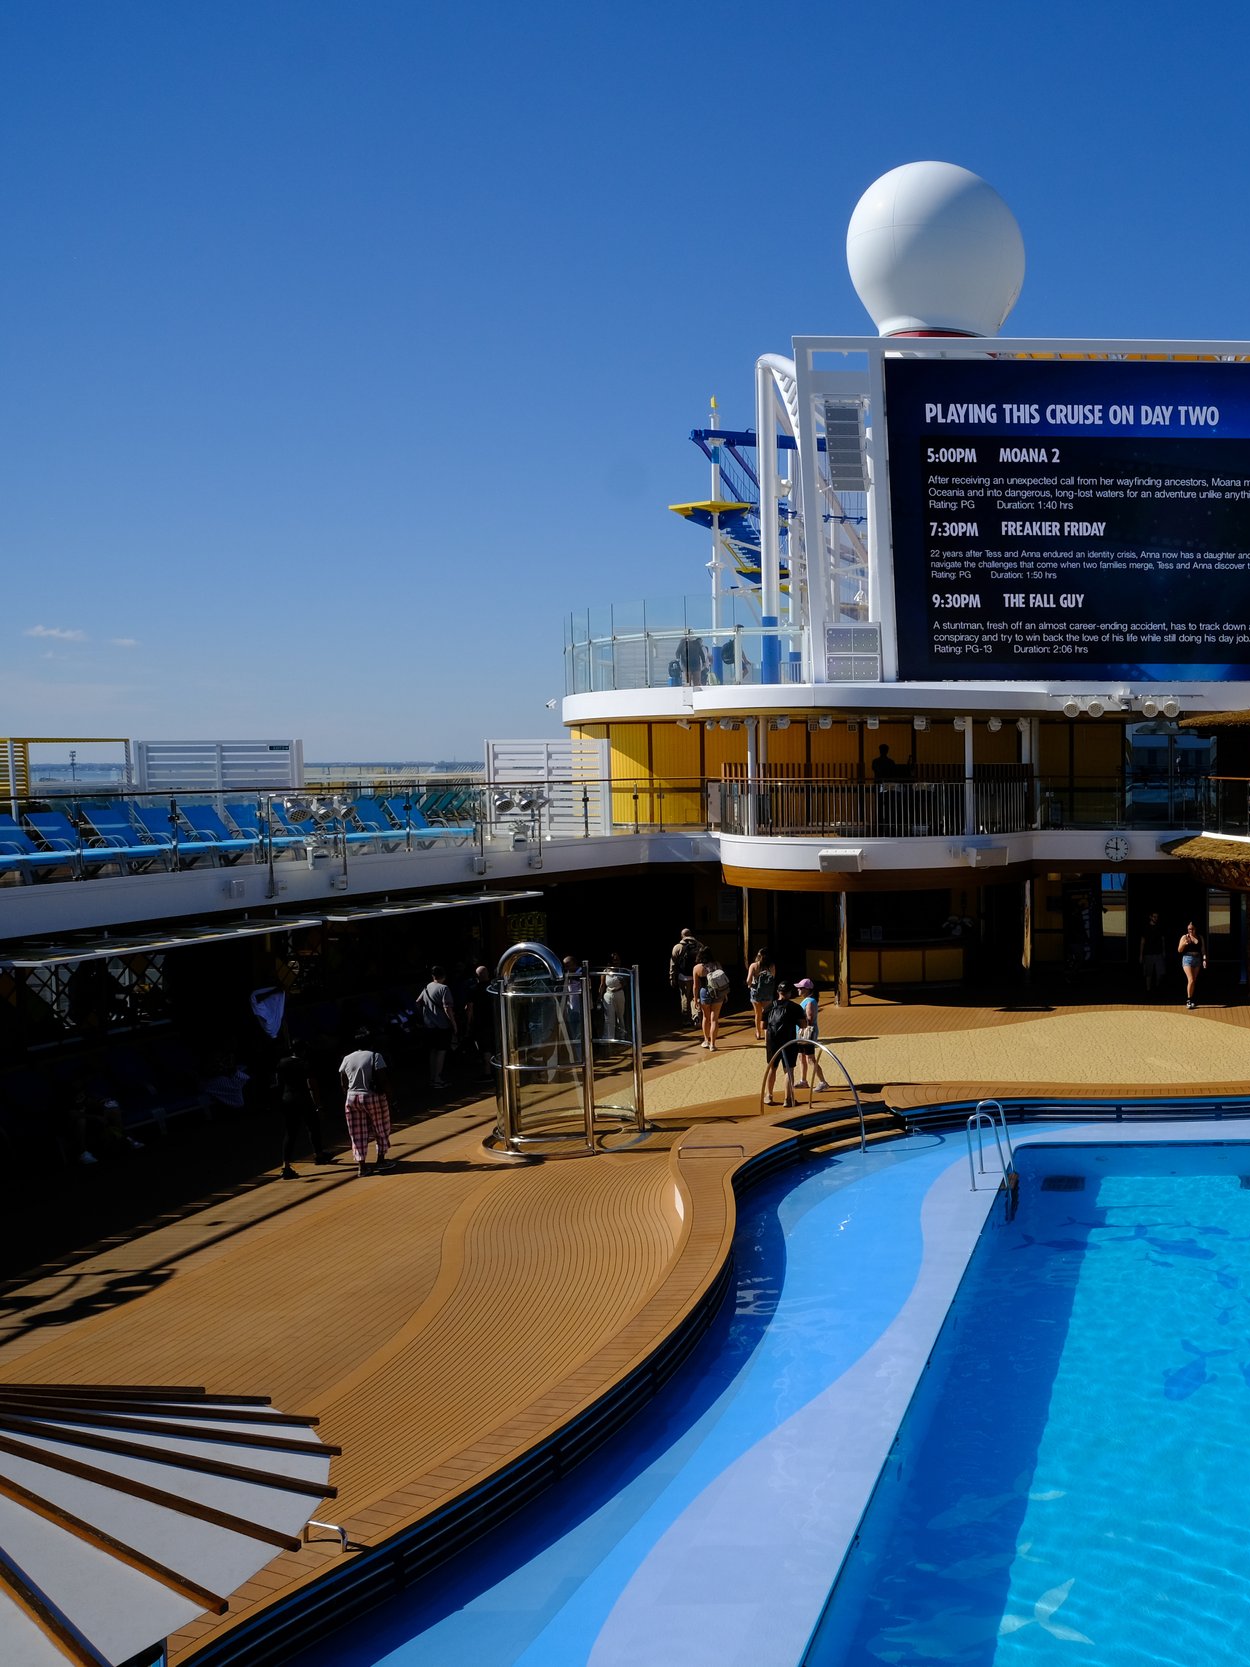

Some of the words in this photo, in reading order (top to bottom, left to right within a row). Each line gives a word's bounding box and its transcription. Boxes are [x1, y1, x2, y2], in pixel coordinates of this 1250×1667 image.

[925, 403, 996, 423] PLAYING
[1002, 403, 1040, 424] THIS
[1046, 404, 1102, 424] CRUISE
[1108, 405, 1133, 424] ON
[1141, 405, 1173, 425] DAY
[1178, 406, 1219, 425] TWO
[927, 448, 976, 462] 5:00PM
[999, 447, 1047, 462] MOANA
[1051, 448, 1059, 462] 2
[927, 475, 949, 484] After
[951, 475, 990, 486] receiving
[1006, 476, 1057, 486] unexpected
[1059, 476, 1074, 485] call
[1077, 476, 1097, 485] from
[1099, 477, 1114, 485] her
[1116, 476, 1161, 488] wayfinding
[1164, 478, 1208, 487] ancestors,
[1211, 477, 1241, 486] Moana
[928, 487, 964, 496] Oceania
[967, 488, 984, 496] and
[986, 488, 1002, 496] into
[1004, 488, 1052, 499] dangerous,
[1055, 488, 1093, 499] long-lost
[1095, 489, 1124, 497] waters
[1126, 489, 1138, 498] for
[1154, 489, 1196, 498] adventure
[1198, 489, 1222, 498] unlike
[929, 499, 958, 510] Rating:
[960, 499, 975, 509] PG
[996, 500, 1034, 509] Duration:
[1038, 500, 1057, 509] 1:40
[1059, 501, 1073, 509] hrs
[929, 522, 978, 536] 7:30PM
[1001, 521, 1060, 535] FREAKIER
[1064, 521, 1106, 536] FRIDAY
[930, 549, 939, 557] 22
[942, 551, 963, 559] years
[965, 549, 982, 557] after
[985, 549, 1001, 557] Tess
[1042, 550, 1073, 559] endured
[1087, 550, 1114, 561] identity
[1116, 550, 1137, 561] crisis,
[1140, 550, 1160, 560] Anna
[1203, 551, 1235, 562] daughter
[930, 560, 961, 571] navigate
[963, 560, 975, 569] the
[978, 560, 1017, 572] challenges
[1019, 560, 1034, 570] that
[1036, 562, 1057, 570] come
[1129, 562, 1154, 570] merge,
[1156, 561, 1173, 569] Tess
[1192, 561, 1212, 569] Anna
[1214, 561, 1245, 569] discover
[931, 570, 956, 580] Rating:
[958, 570, 971, 578] PG
[990, 570, 1023, 578] Duration:
[932, 594, 980, 607] 9:30PM
[1003, 593, 1025, 607] THE
[1029, 593, 1055, 607] FALL
[1059, 594, 1084, 607] GUY
[933, 621, 940, 629] A
[942, 621, 984, 630] stuntman,
[986, 621, 1008, 629] fresh
[1010, 621, 1022, 629] off
[1038, 621, 1066, 629] almost
[1069, 621, 1127, 632] career-ending
[1130, 621, 1167, 631] accident,
[1170, 622, 1186, 630] has
[1188, 622, 1197, 630] to
[1199, 622, 1220, 630] track
[1222, 622, 1246, 630] down
[933, 632, 979, 643] conspiracy
[981, 633, 998, 641] and
[1000, 633, 1012, 643] try
[1015, 633, 1023, 641] to
[1025, 633, 1040, 641] win
[1042, 633, 1063, 641] back
[1066, 633, 1079, 641] the
[1082, 633, 1098, 641] love
[1101, 633, 1109, 641] of
[1112, 633, 1124, 641] his
[1126, 633, 1137, 642] life
[1140, 633, 1161, 641] while
[1163, 633, 1176, 642] still
[1178, 633, 1201, 644] doing
[1204, 634, 1216, 642] his
[1218, 634, 1233, 644] day
[1236, 634, 1250, 644] job.
[934, 644, 962, 655] Rating:
[965, 644, 992, 653] PG-13
[1013, 644, 1050, 653] Duration:
[1053, 644, 1072, 653] 2:06
[1074, 645, 1088, 653] hrs
